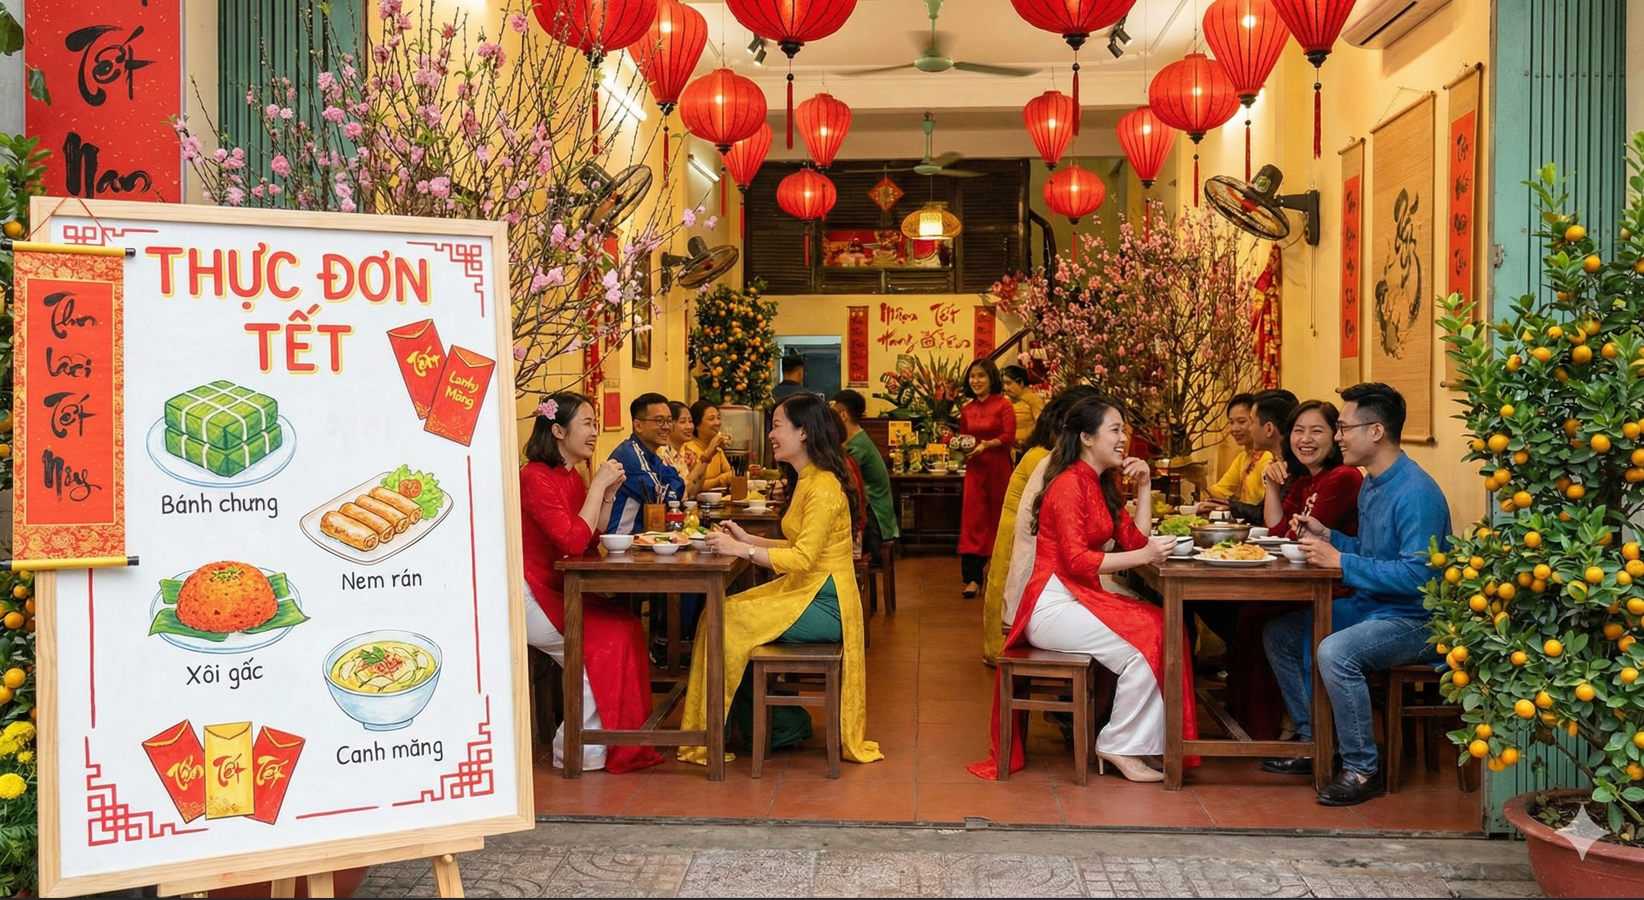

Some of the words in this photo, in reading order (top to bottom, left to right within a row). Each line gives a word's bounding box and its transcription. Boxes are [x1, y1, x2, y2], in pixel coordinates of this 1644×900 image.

[65, 25, 157, 107] Tết
[144, 242, 302, 313] THỰC
[317, 249, 433, 305] ĐƠN
[929, 302, 961, 327] Tết
[244, 303, 355, 374] TẾT
[43, 391, 97, 438] Tết
[161, 492, 212, 514] Bánh
[219, 492, 278, 518] chưng
[342, 571, 385, 590] Nem
[391, 568, 422, 588] rán
[186, 664, 220, 686] Xôi
[228, 657, 263, 690] gấc
[336, 740, 385, 765] Canh
[392, 738, 444, 762] măng
[213, 753, 247, 788] Tết
[256, 755, 289, 789] Tết
